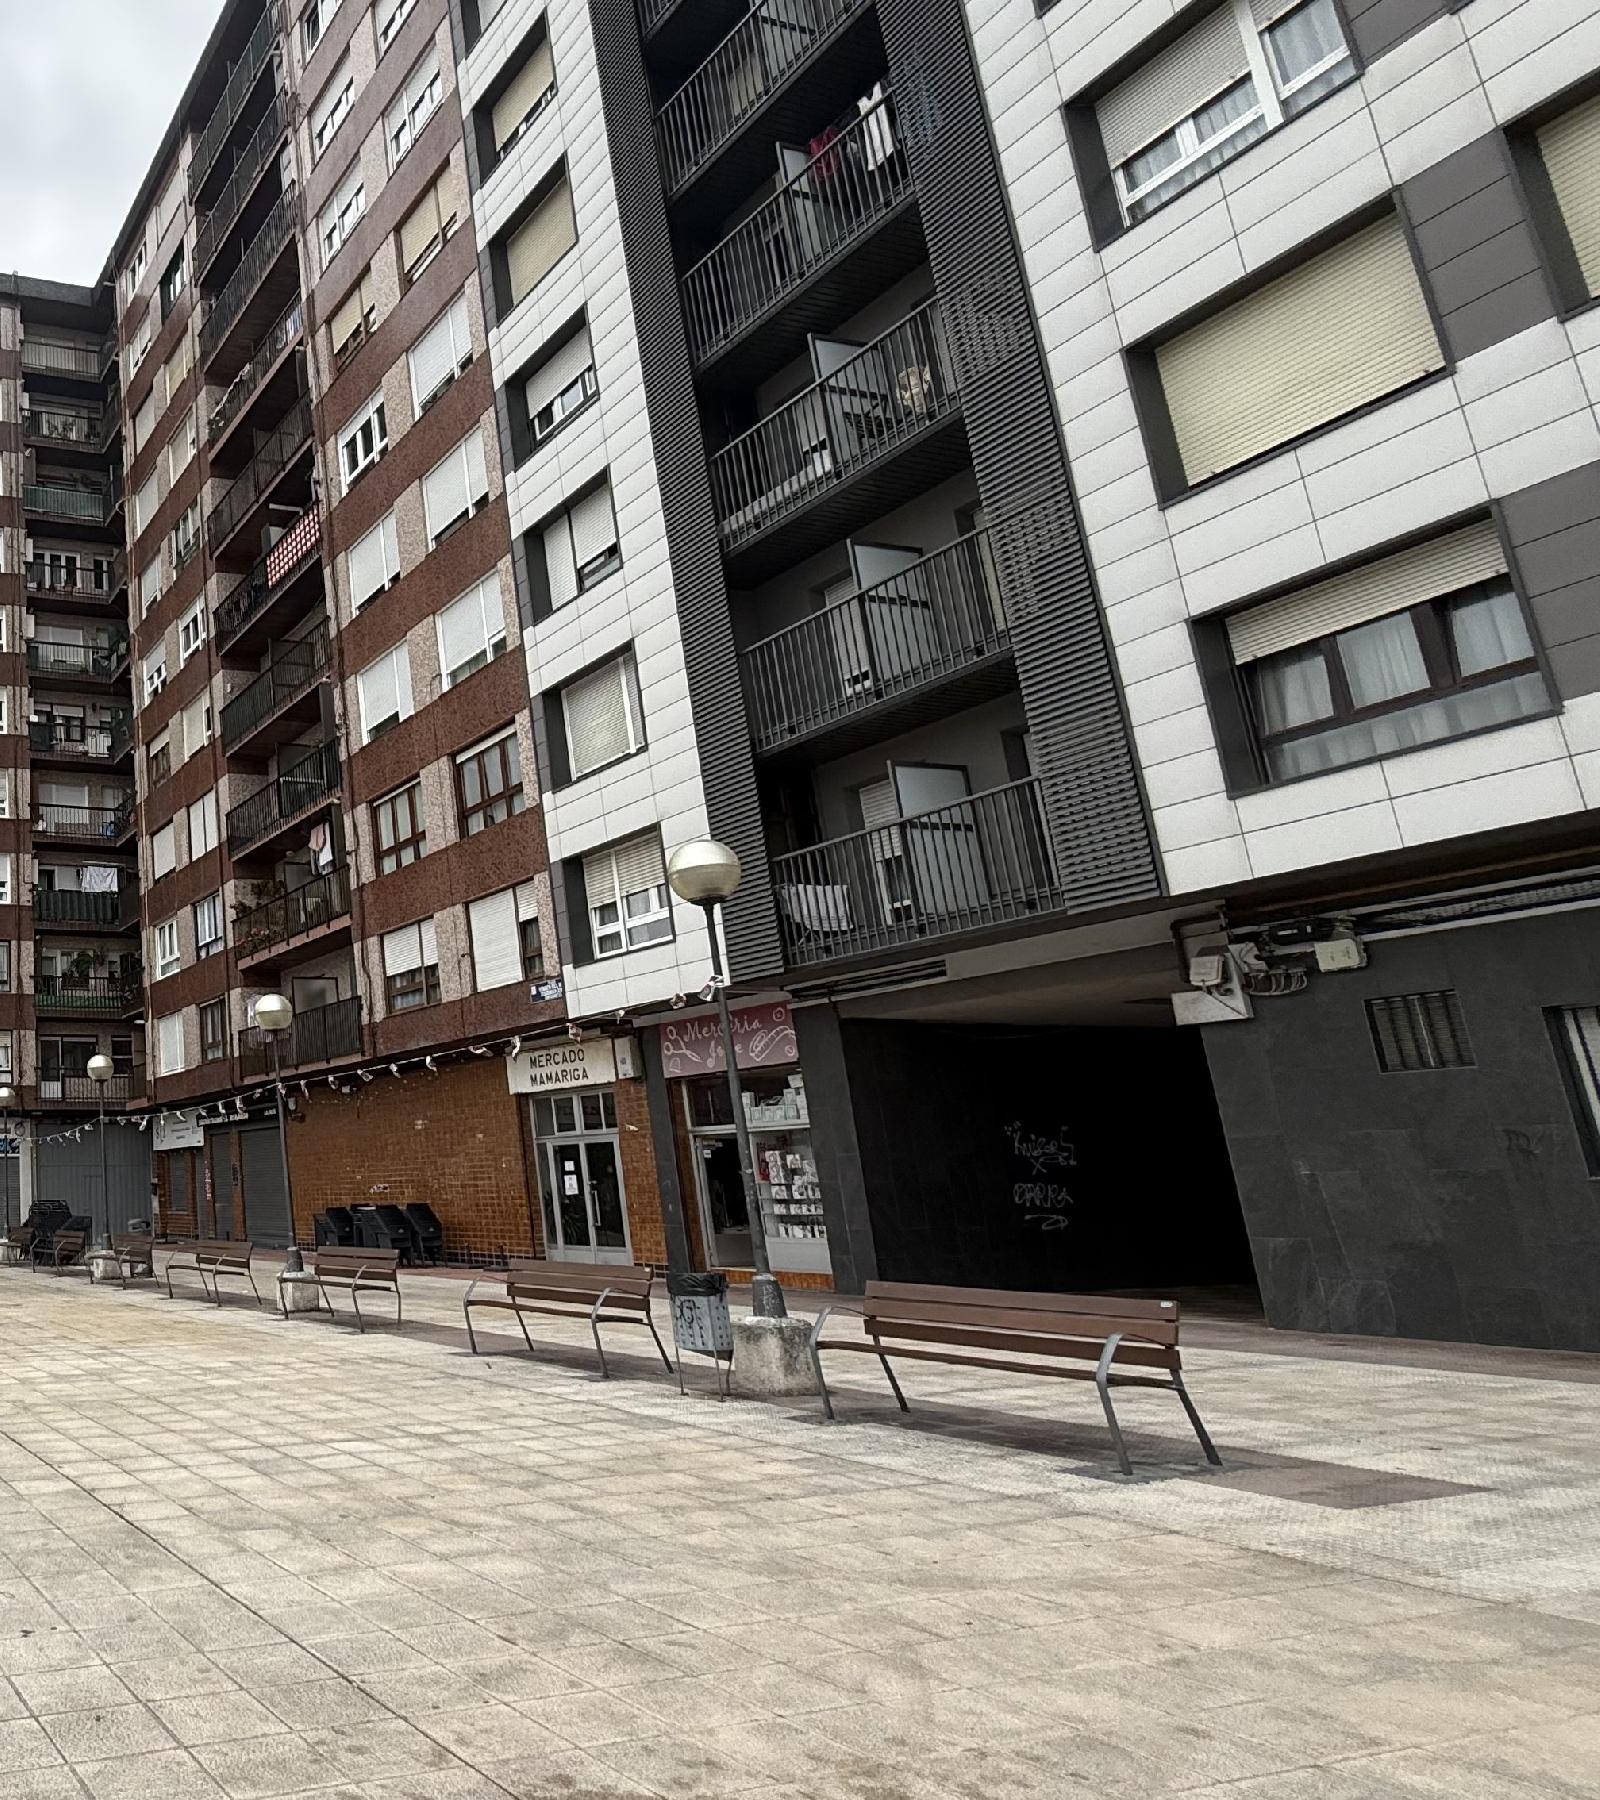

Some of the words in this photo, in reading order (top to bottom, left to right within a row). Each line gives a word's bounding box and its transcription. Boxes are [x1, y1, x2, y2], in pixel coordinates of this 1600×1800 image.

[683, 1013, 762, 1042] Mercria
[529, 1048, 585, 1069] MERCADO
[706, 1041, 743, 1068] Joe
[529, 1067, 589, 1087] MAMARIGA
